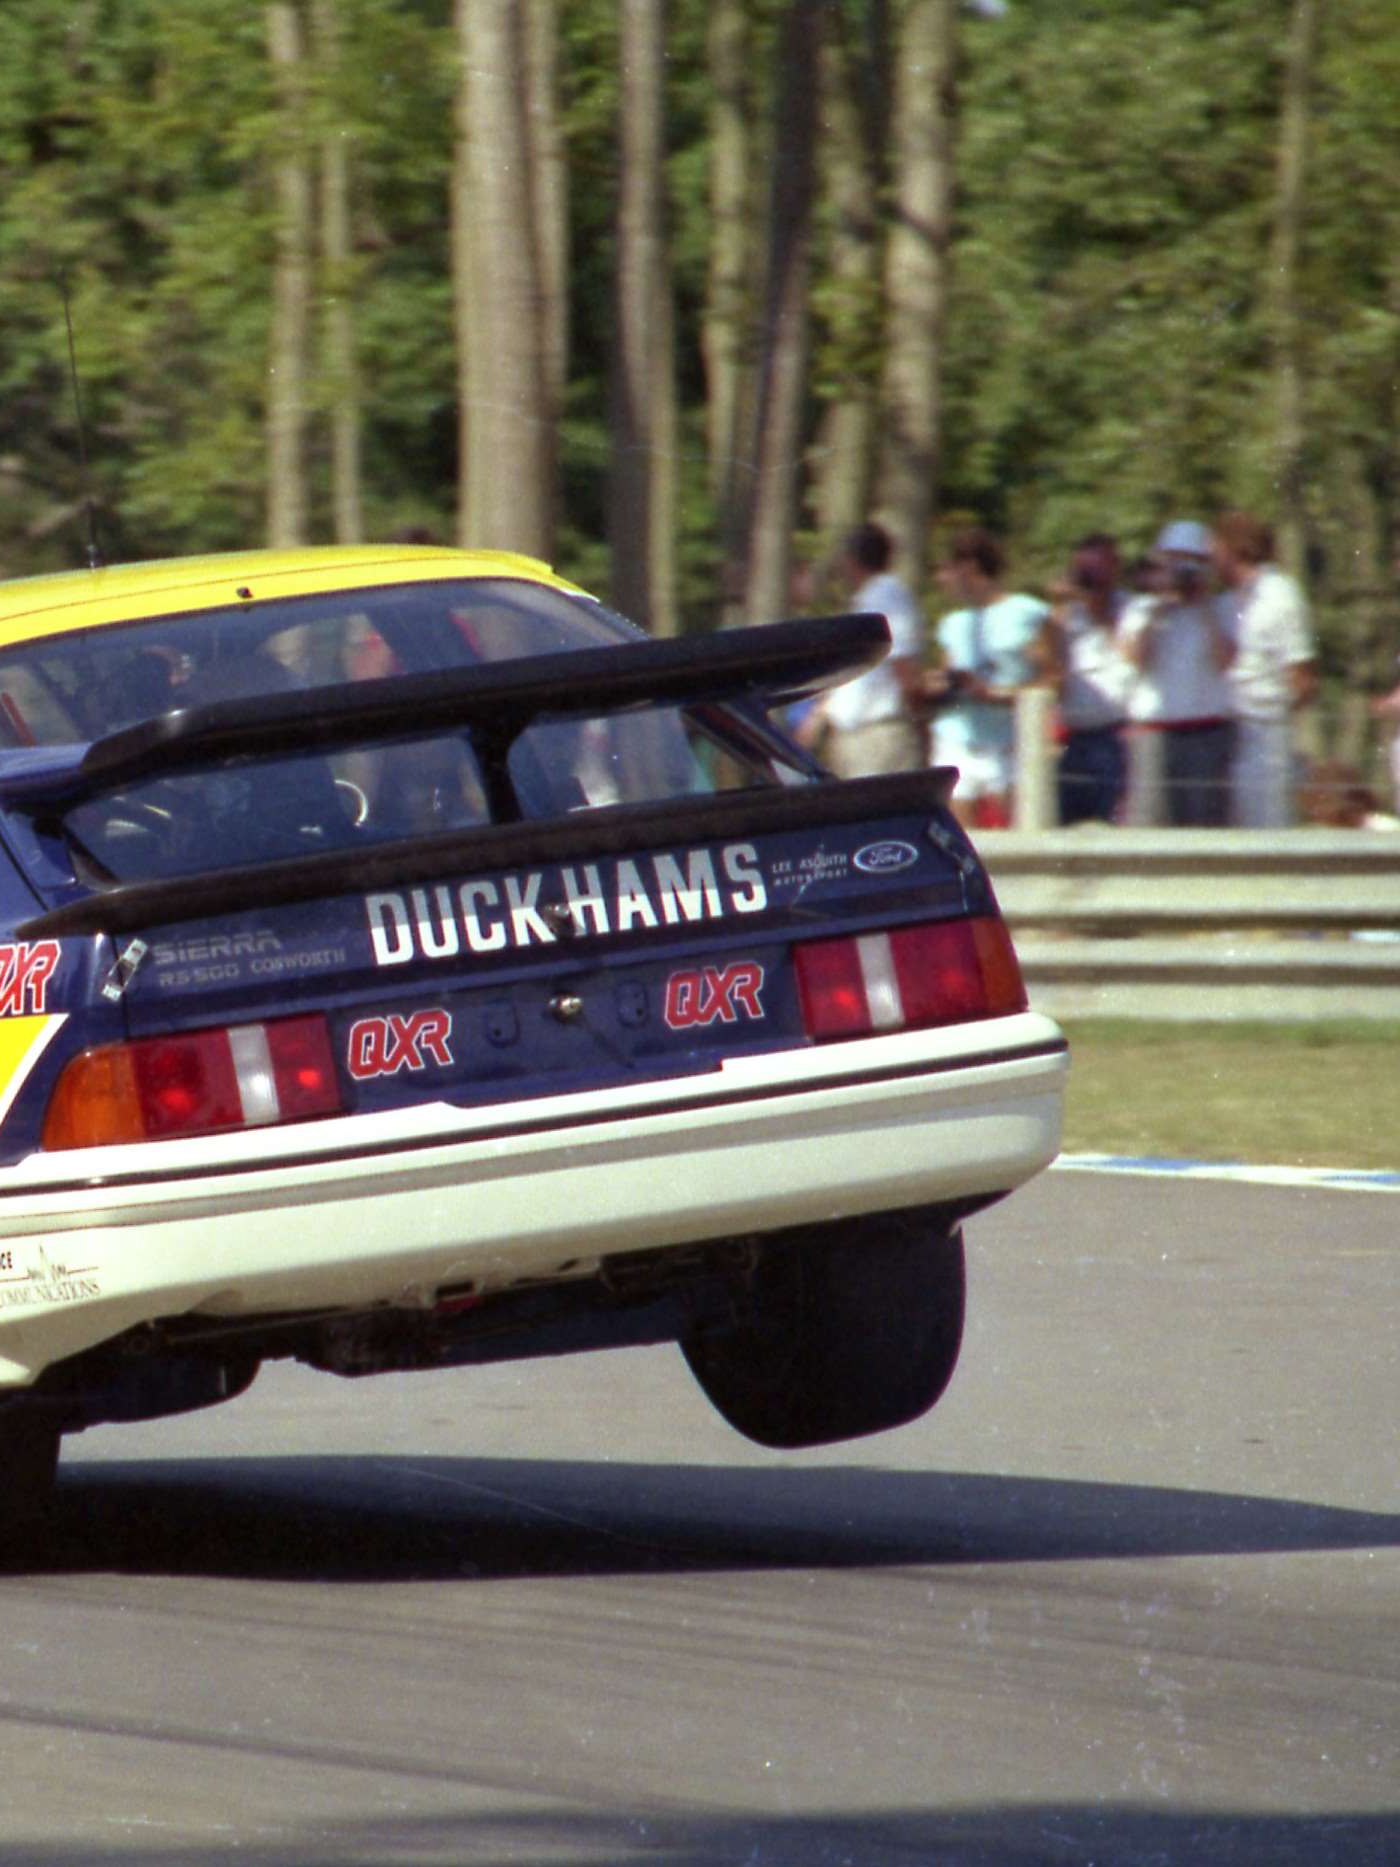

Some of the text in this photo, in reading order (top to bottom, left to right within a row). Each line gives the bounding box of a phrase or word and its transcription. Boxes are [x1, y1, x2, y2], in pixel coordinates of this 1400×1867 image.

[772, 861, 792, 874] LEE
[868, 848, 903, 866] Ford
[365, 842, 768, 967] DUCKHAMS
[153, 930, 282, 966] SIERRA
[251, 947, 347, 974] COSWORTH
[663, 961, 766, 1030] QXR
[346, 1008, 454, 1080] QXR
